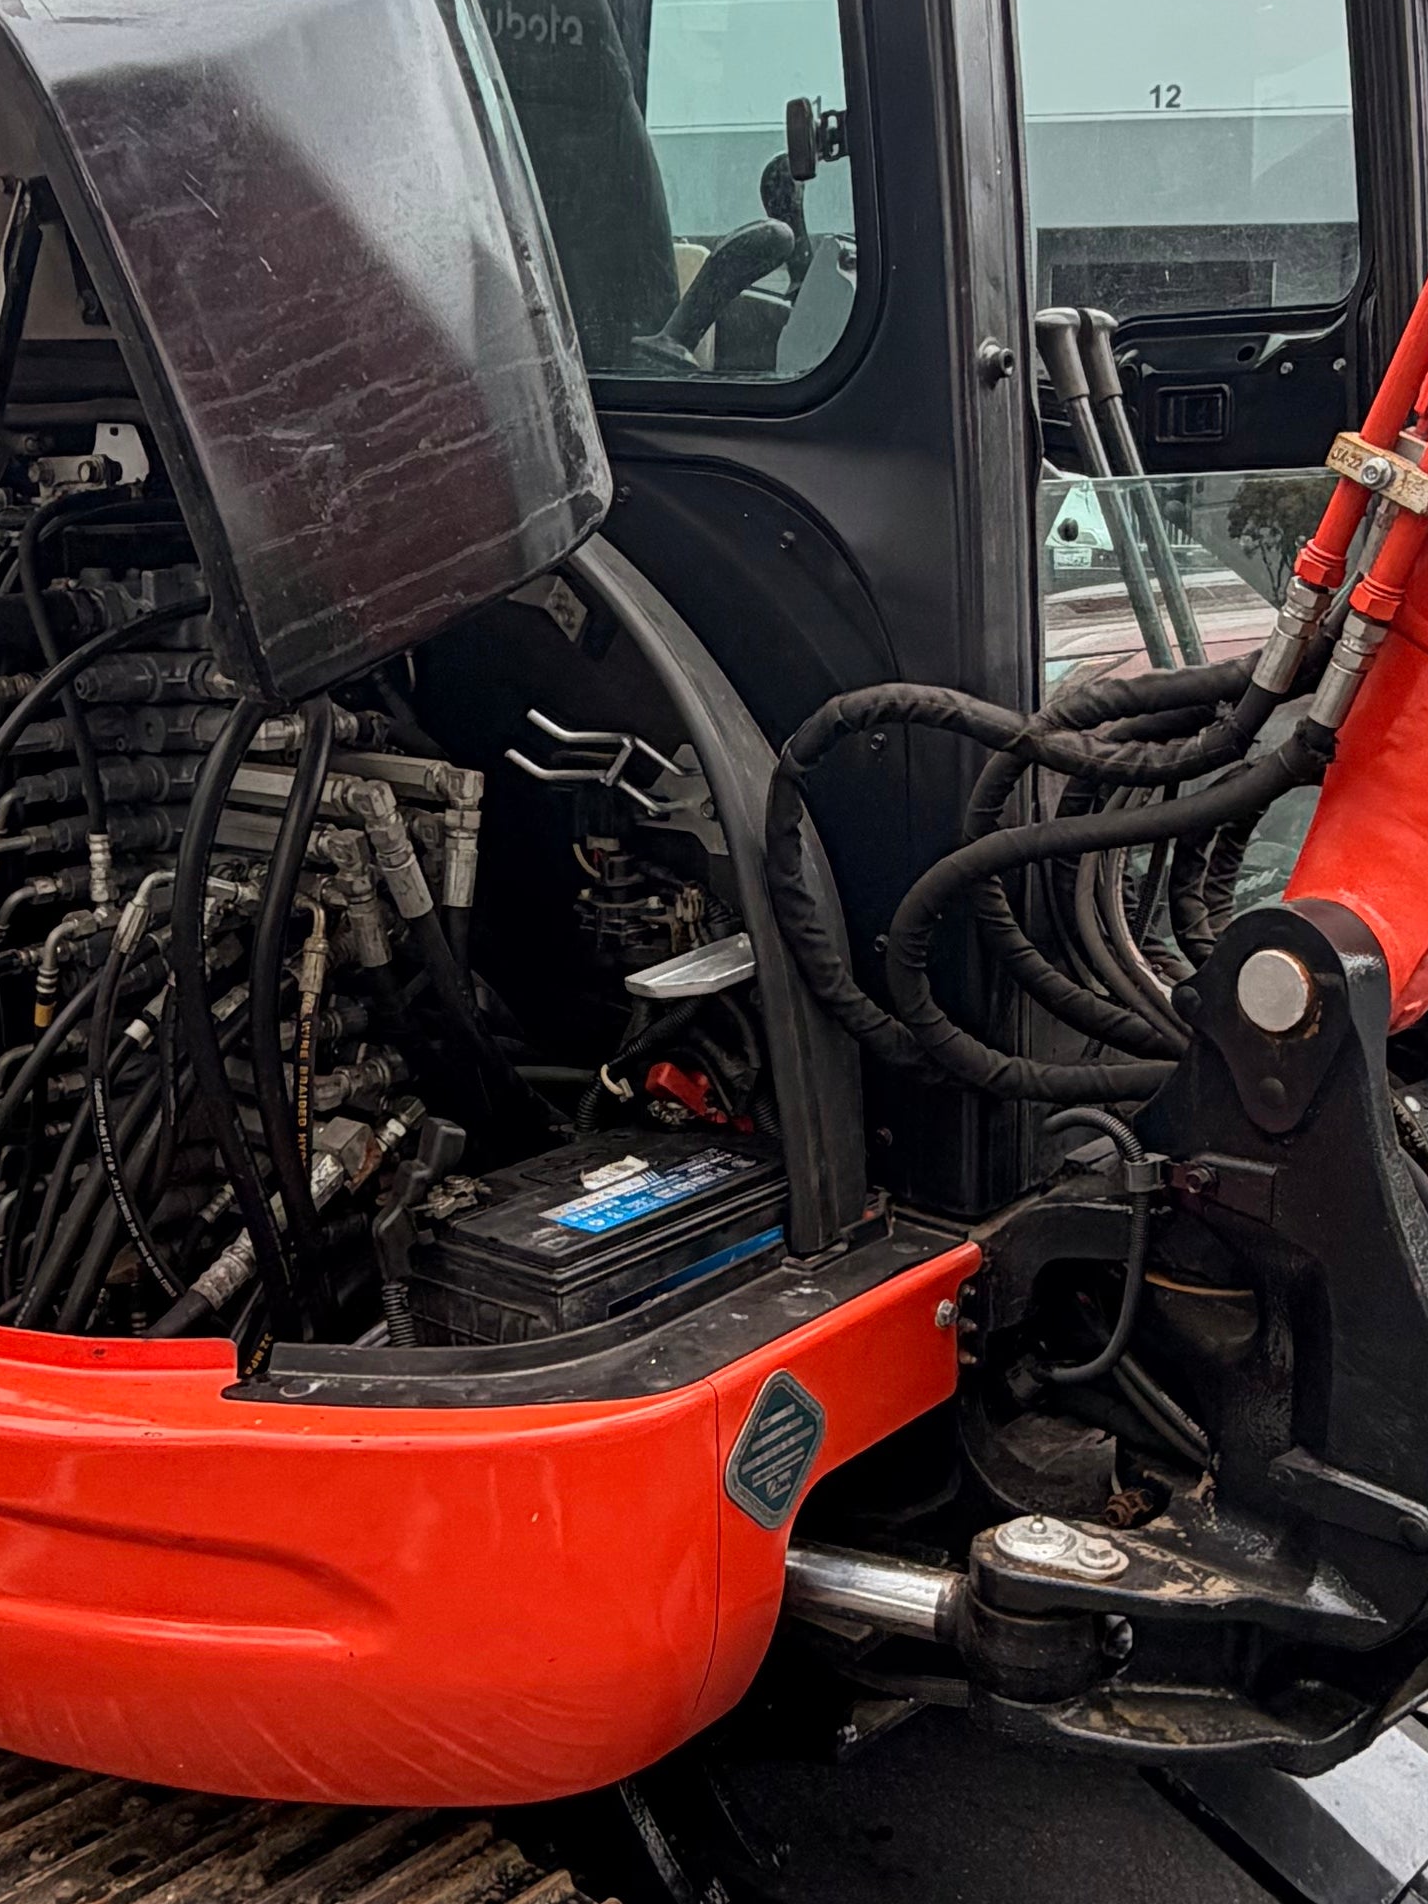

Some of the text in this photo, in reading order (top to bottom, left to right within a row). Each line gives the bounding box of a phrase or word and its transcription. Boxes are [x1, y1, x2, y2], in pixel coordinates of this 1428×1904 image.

[481, 0, 584, 45] ubota
[1149, 84, 1182, 109] 12
[299, 1020, 311, 1059] WIRE
[297, 1065, 310, 1127] BRAIDED
